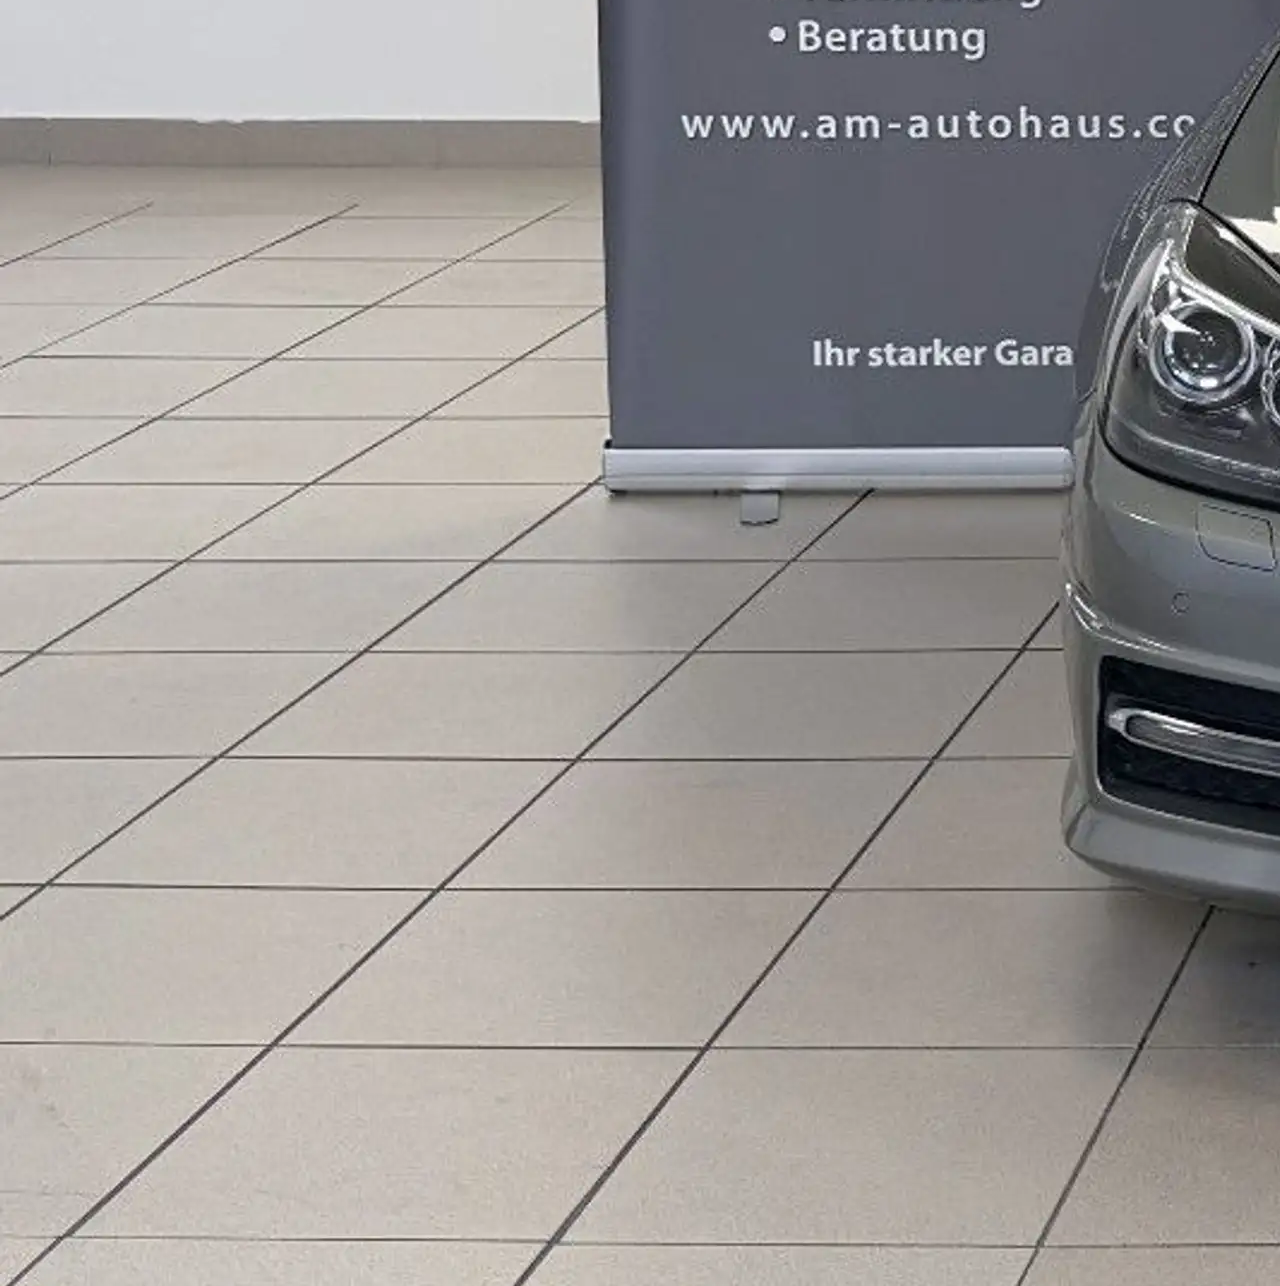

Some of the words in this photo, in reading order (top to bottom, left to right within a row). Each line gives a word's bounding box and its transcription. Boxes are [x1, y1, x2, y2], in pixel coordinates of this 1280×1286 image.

[798, 19, 986, 61] Beratung
[681, 105, 1196, 139] www.am-autohaus.co
[813, 338, 861, 368] Ihr
[868, 338, 988, 368] starker
[994, 339, 1074, 368] Gara
